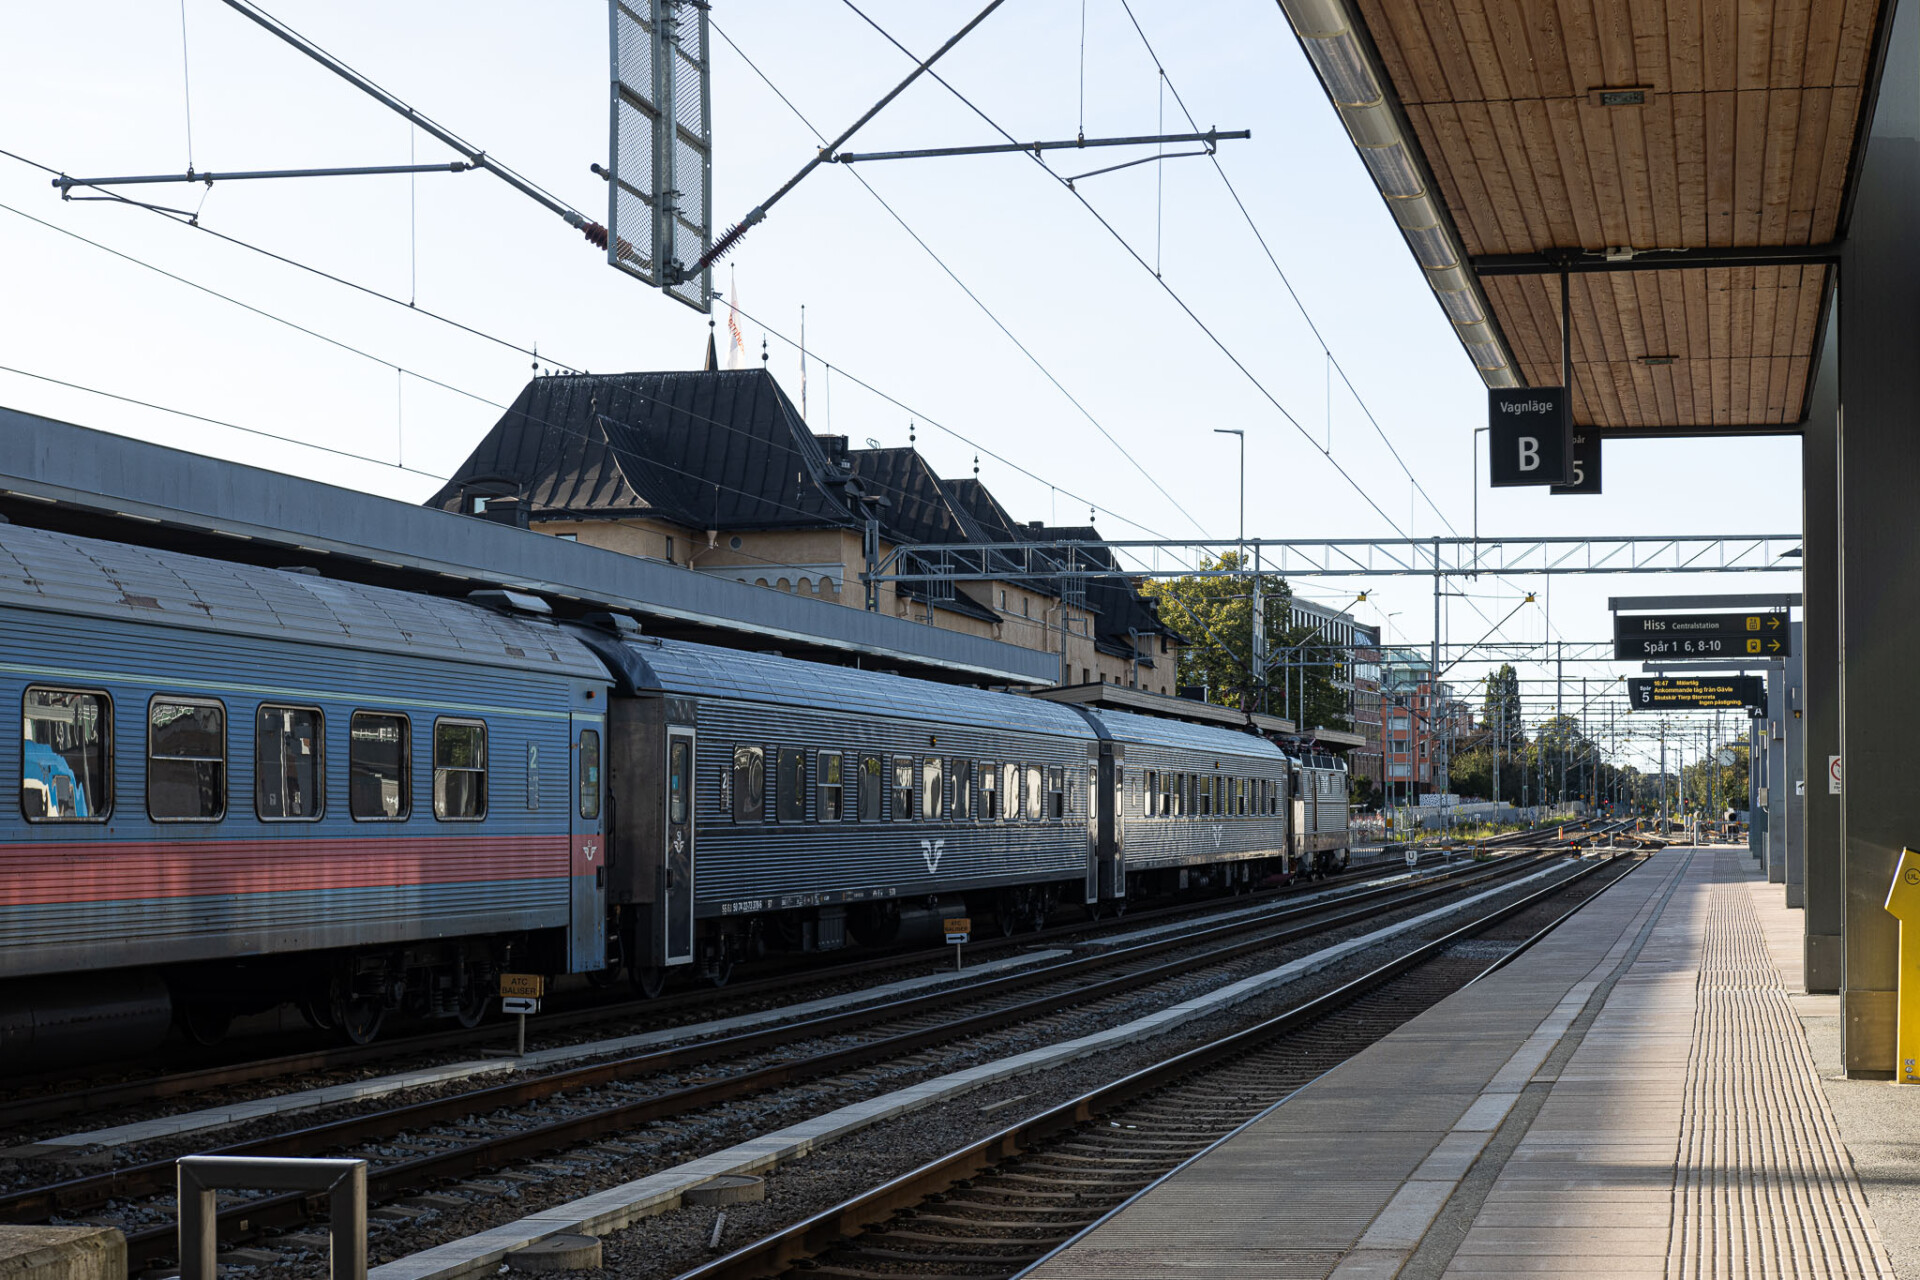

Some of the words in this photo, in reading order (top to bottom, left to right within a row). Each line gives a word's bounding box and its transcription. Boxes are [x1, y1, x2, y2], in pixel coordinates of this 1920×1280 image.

[1500, 400, 1553, 415] Vagnläge
[1572, 434, 1586, 444] pår
[1518, 436, 1540, 471] B
[1572, 460, 1584, 485] 5
[1643, 619, 1666, 631] Hiss
[1671, 621, 1720, 630] Centralstation
[1643, 640, 1669, 655] Spår
[1671, 641, 1678, 652] 1
[1684, 640, 1695, 653] 6,
[1698, 640, 1722, 652] 8-10
[1642, 691, 1650, 703] 5
[1754, 708, 1763, 716] A
[530, 745, 537, 769] 2
[722, 772, 727, 789] 2
[1408, 851, 1415, 860] U
[511, 977, 528, 986] ATC
